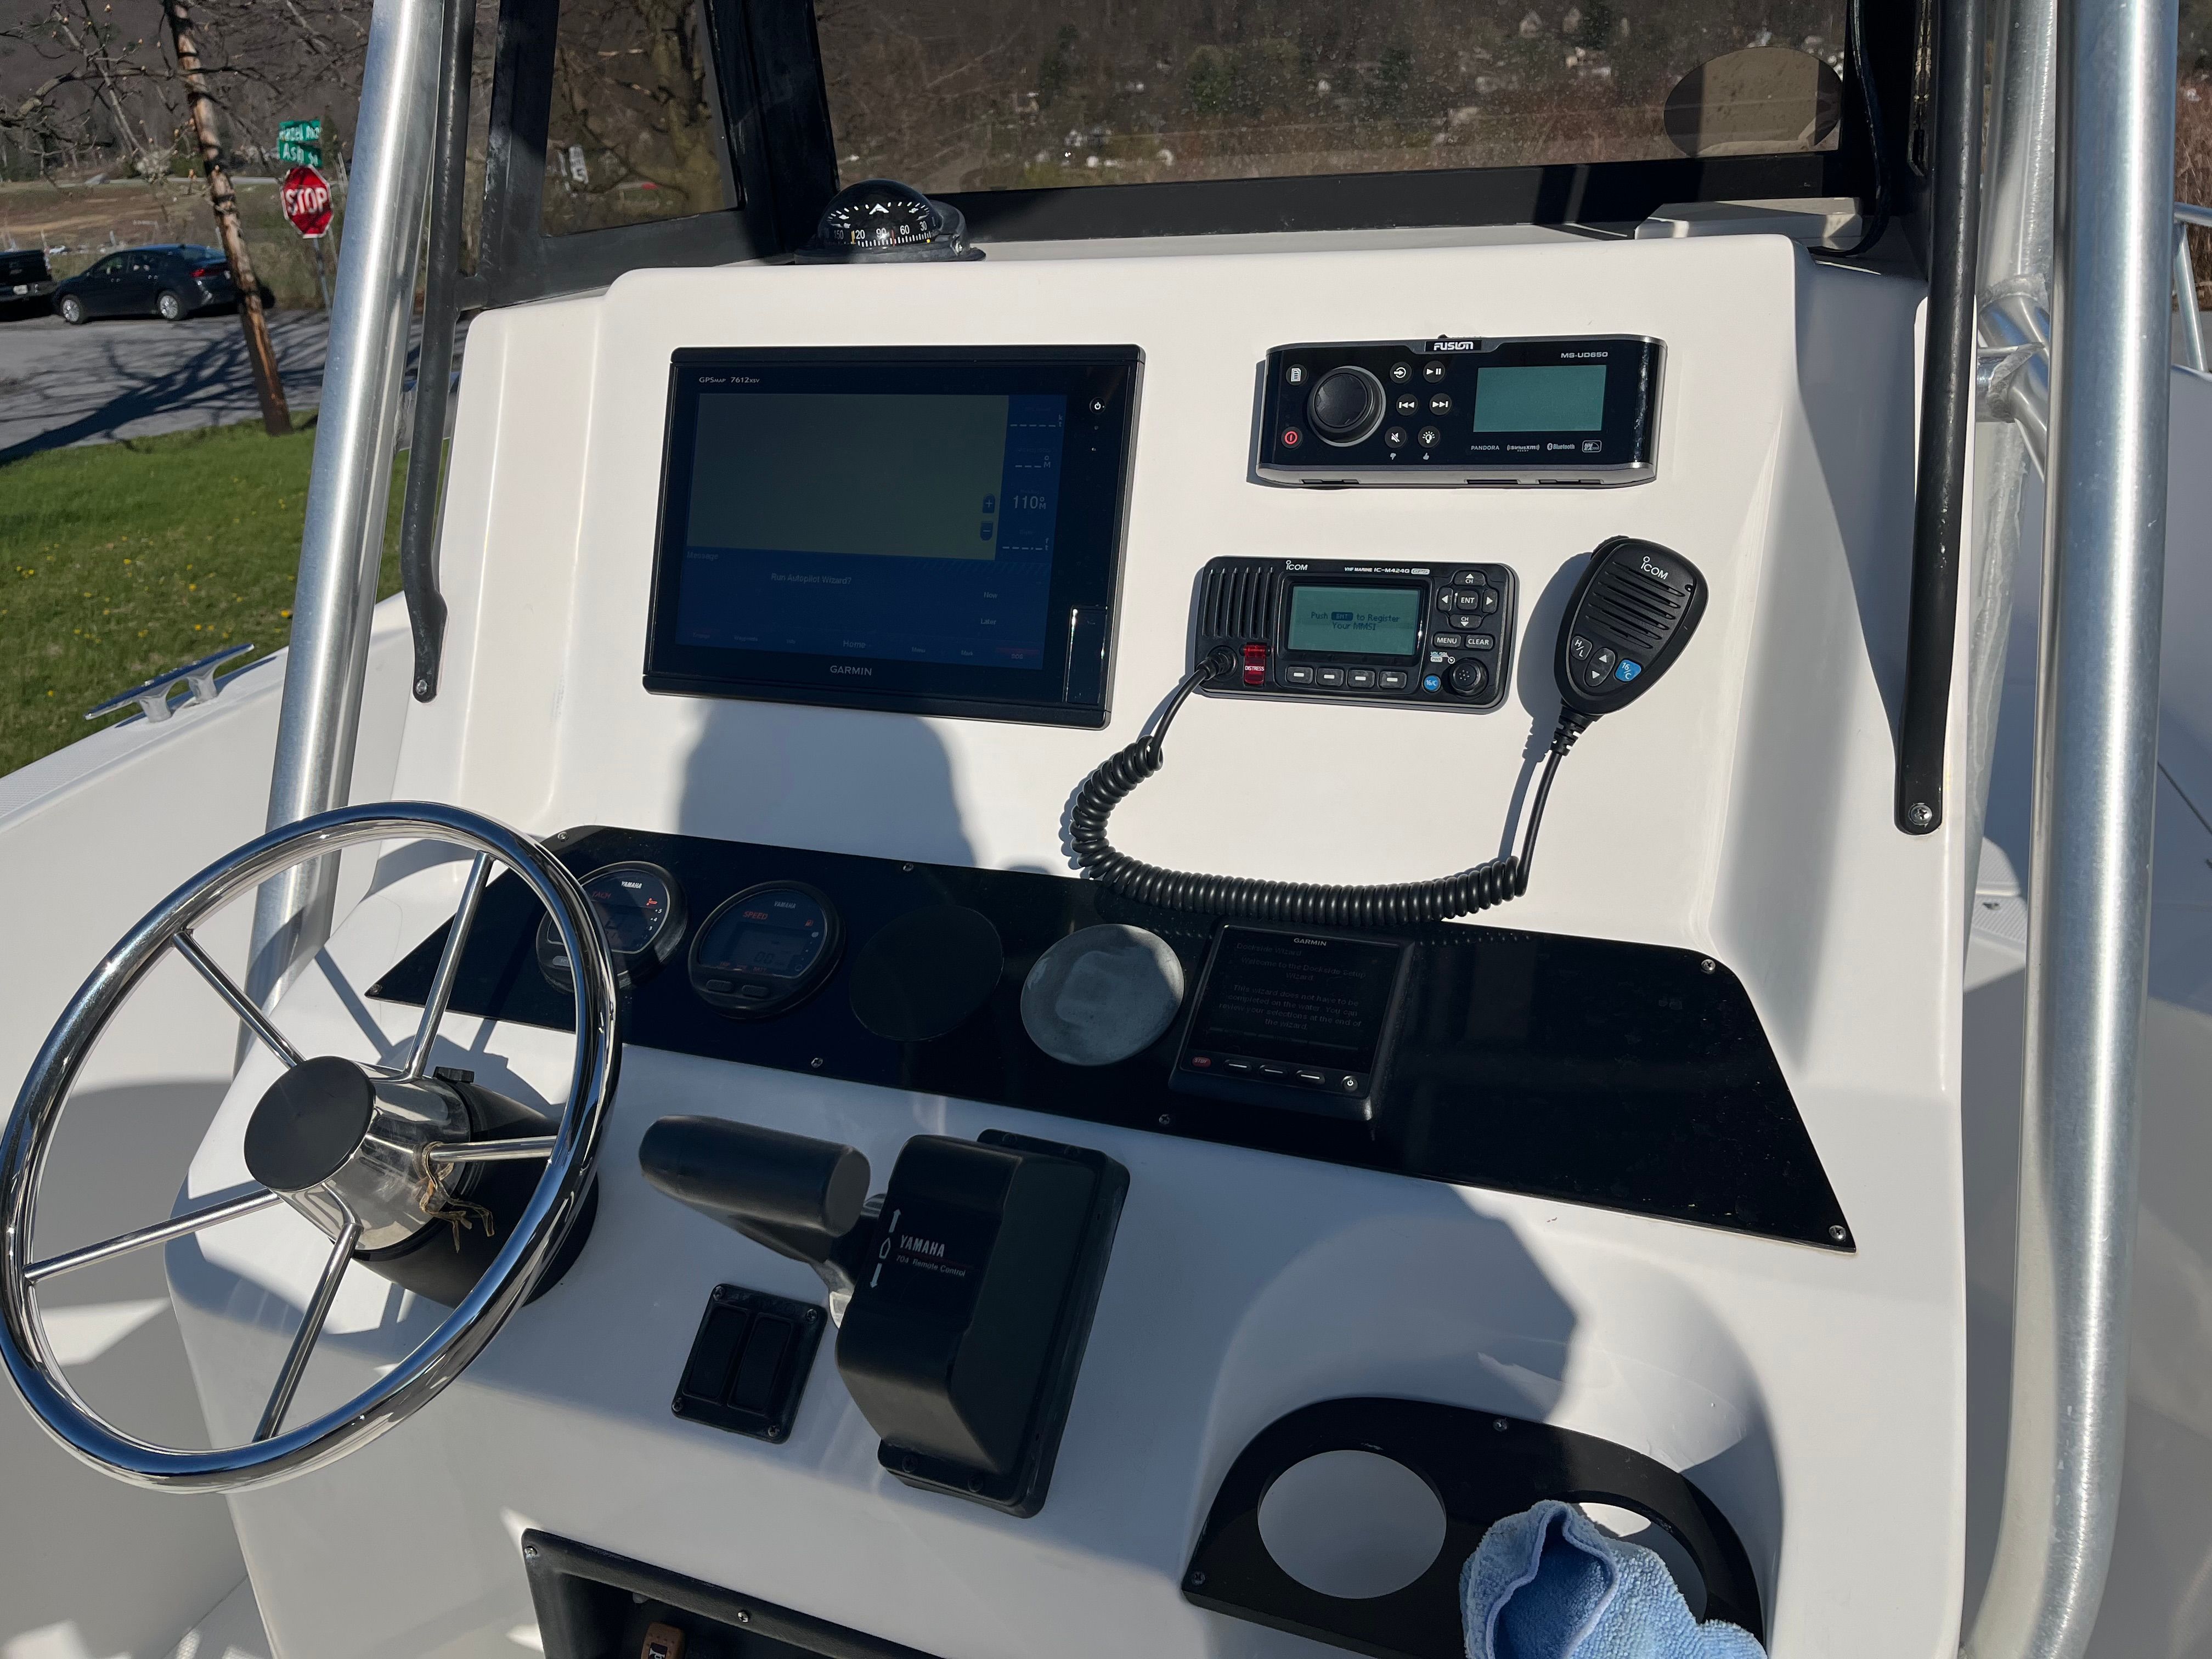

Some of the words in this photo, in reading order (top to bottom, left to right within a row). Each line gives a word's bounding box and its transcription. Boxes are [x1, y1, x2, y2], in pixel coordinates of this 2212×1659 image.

[283, 143, 304, 163] Ash
[286, 187, 328, 215] STOP
[876, 227, 887, 239] 90
[900, 224, 910, 235] 60
[919, 221, 927, 231] 30
[1434, 341, 1474, 351] FUSION
[687, 551, 719, 561] Message
[771, 573, 786, 582] Run
[787, 574, 820, 584] Autopilot
[822, 575, 851, 584] Wizard?
[983, 590, 998, 600] Now
[979, 617, 996, 626] Later
[1368, 614, 1400, 623] Register
[843, 639, 867, 650] Home
[830, 665, 872, 676] GARMIN
[743, 911, 768, 920] SPEED
[1294, 938, 1327, 946] GARMIN
[1242, 957, 1277, 967] Welcome
[1288, 962, 1302, 970] the
[1303, 964, 1341, 975] Dockside
[1343, 970, 1366, 979] Setup
[1234, 984, 1250, 992] This
[1252, 987, 1278, 996] wizard
[1280, 991, 1299, 999] does
[1228, 994, 1269, 1005] completed
[1267, 1009, 1308, 1020] selections
[1319, 1015, 1333, 1024] the
[900, 1234, 945, 1257] YAMAHA
[912, 1258, 938, 1271] Remote
[940, 1265, 966, 1277] Control
